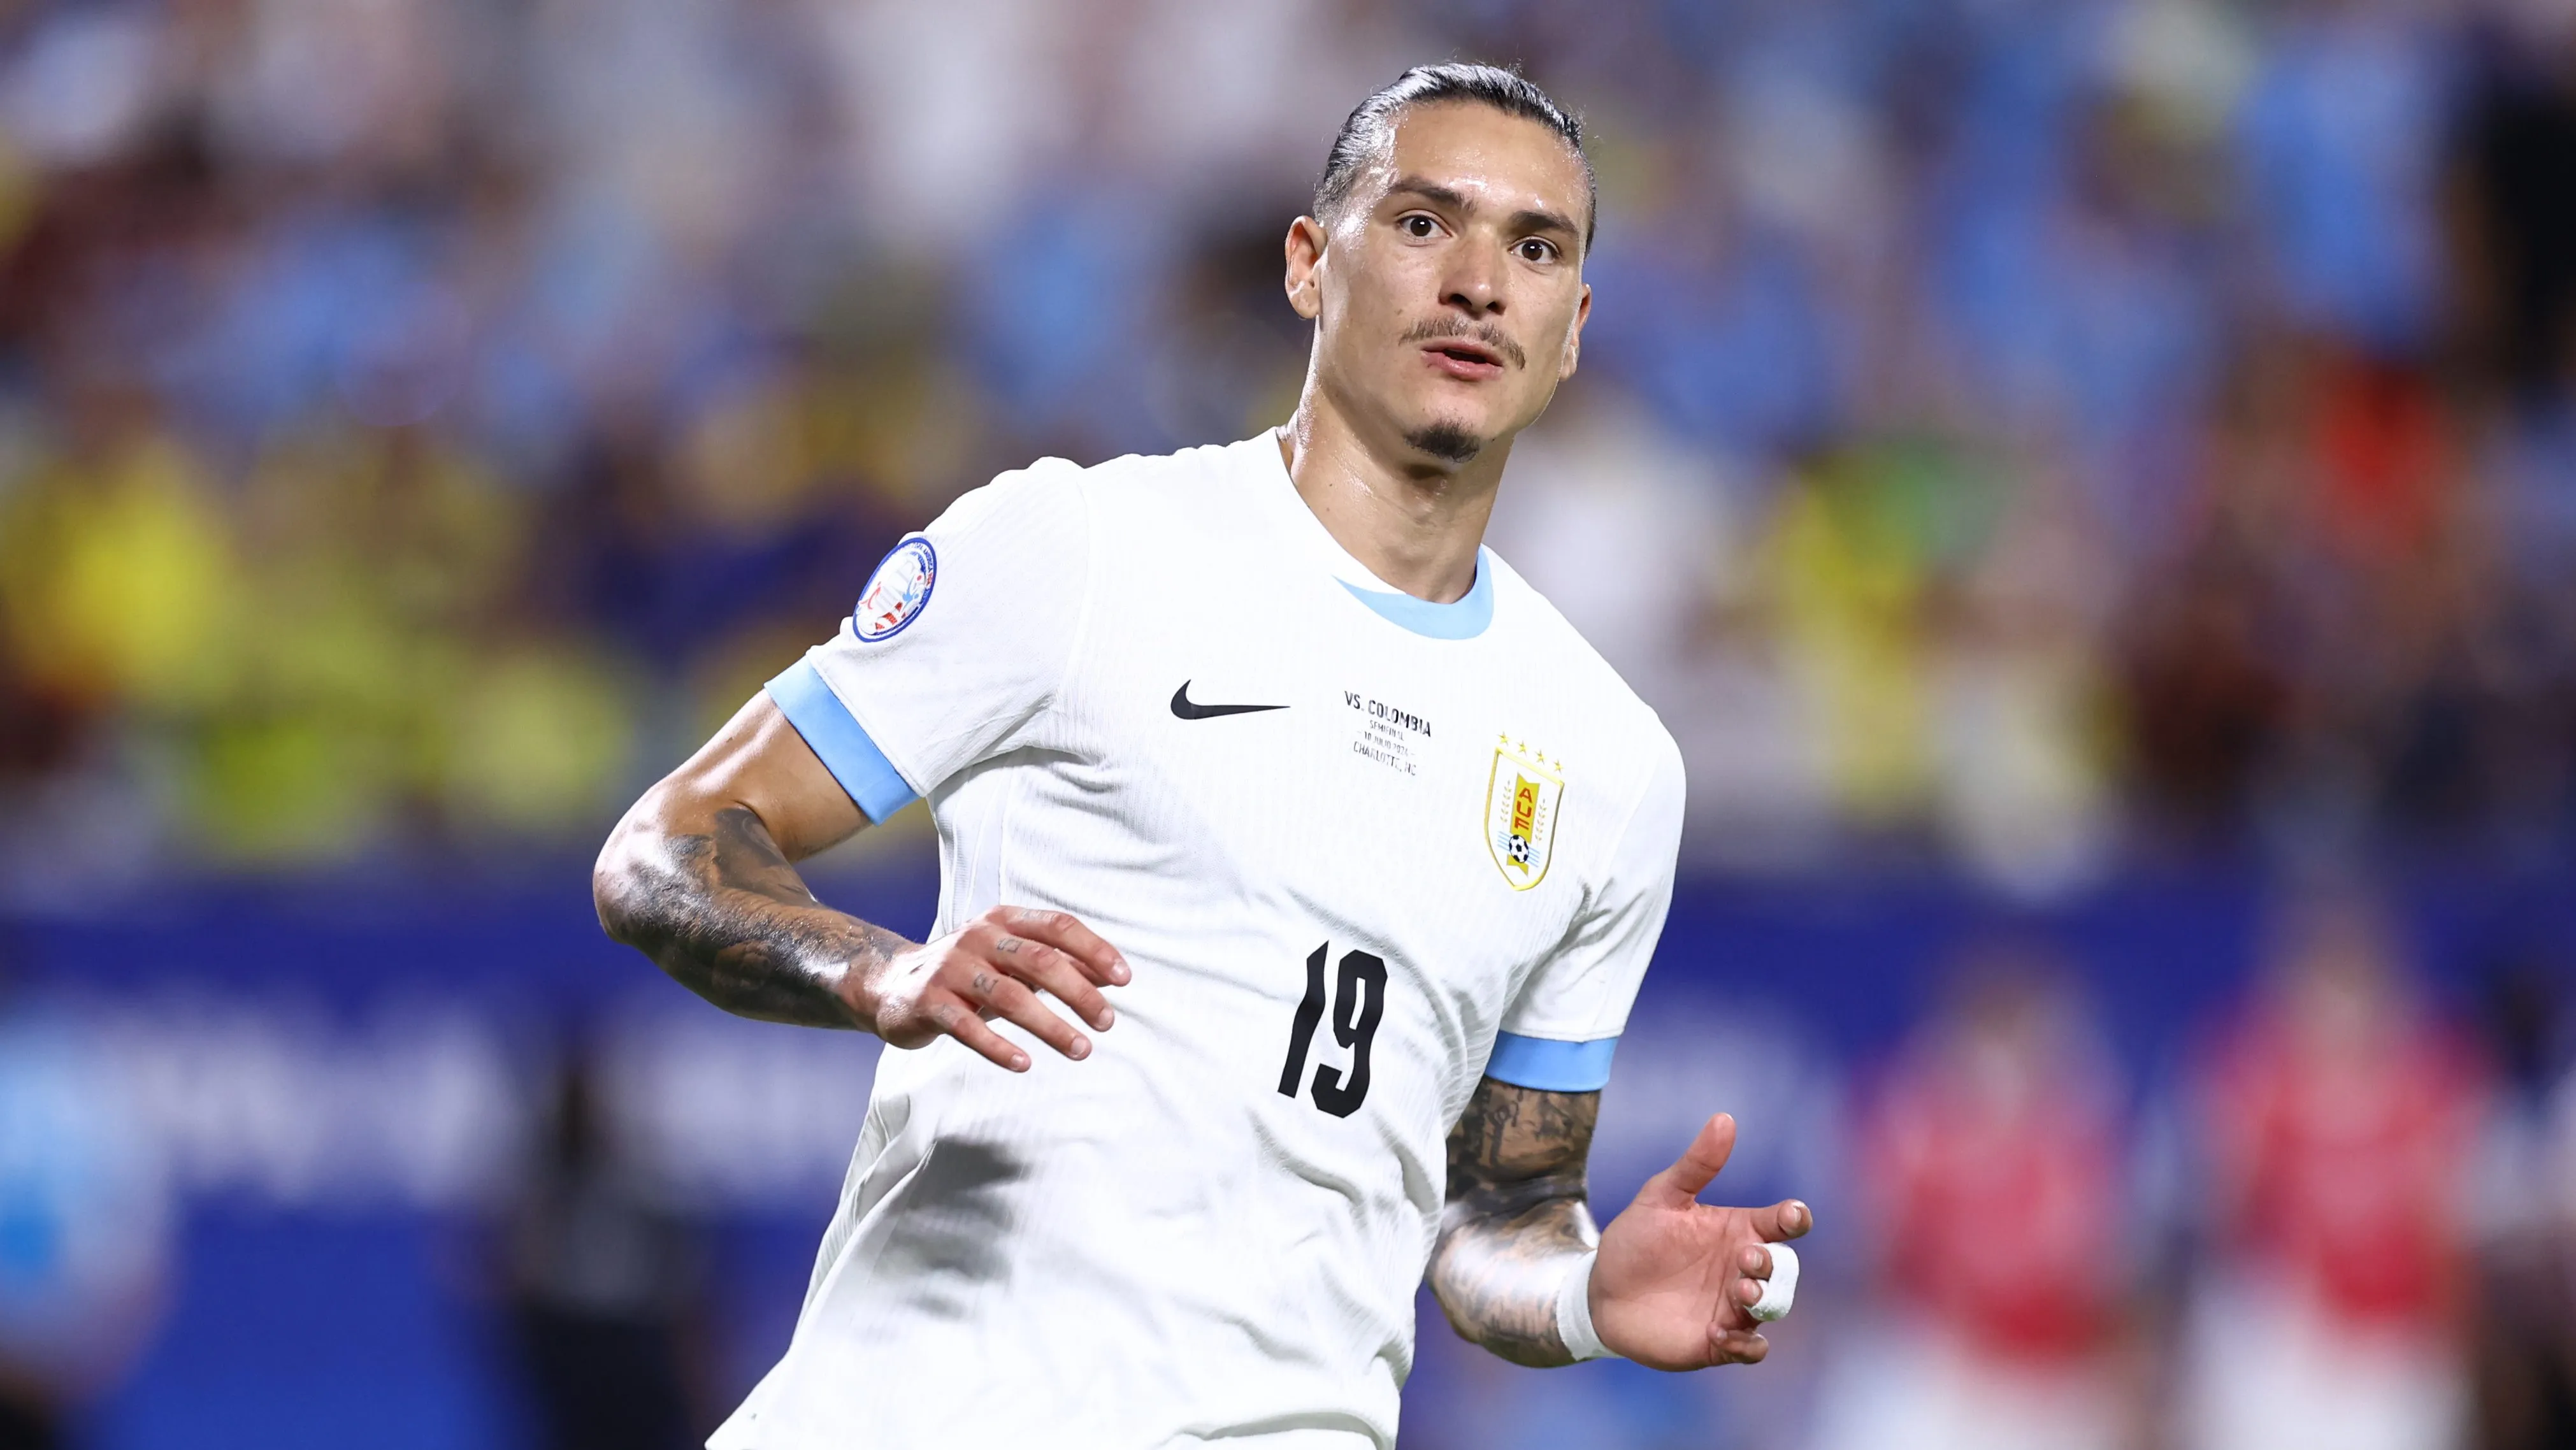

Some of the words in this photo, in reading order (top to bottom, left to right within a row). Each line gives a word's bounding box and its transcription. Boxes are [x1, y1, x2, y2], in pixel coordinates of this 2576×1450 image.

[1344, 691, 1365, 711] VS.
[1367, 700, 1431, 737] COLOMBIA
[1369, 720, 1405, 741] SEMIFINAL
[1353, 741, 1402, 772] CHARLOTTE,
[1404, 761, 1417, 776] NC
[1514, 787, 1534, 831] AUF
[1277, 940, 1388, 1119] 19
